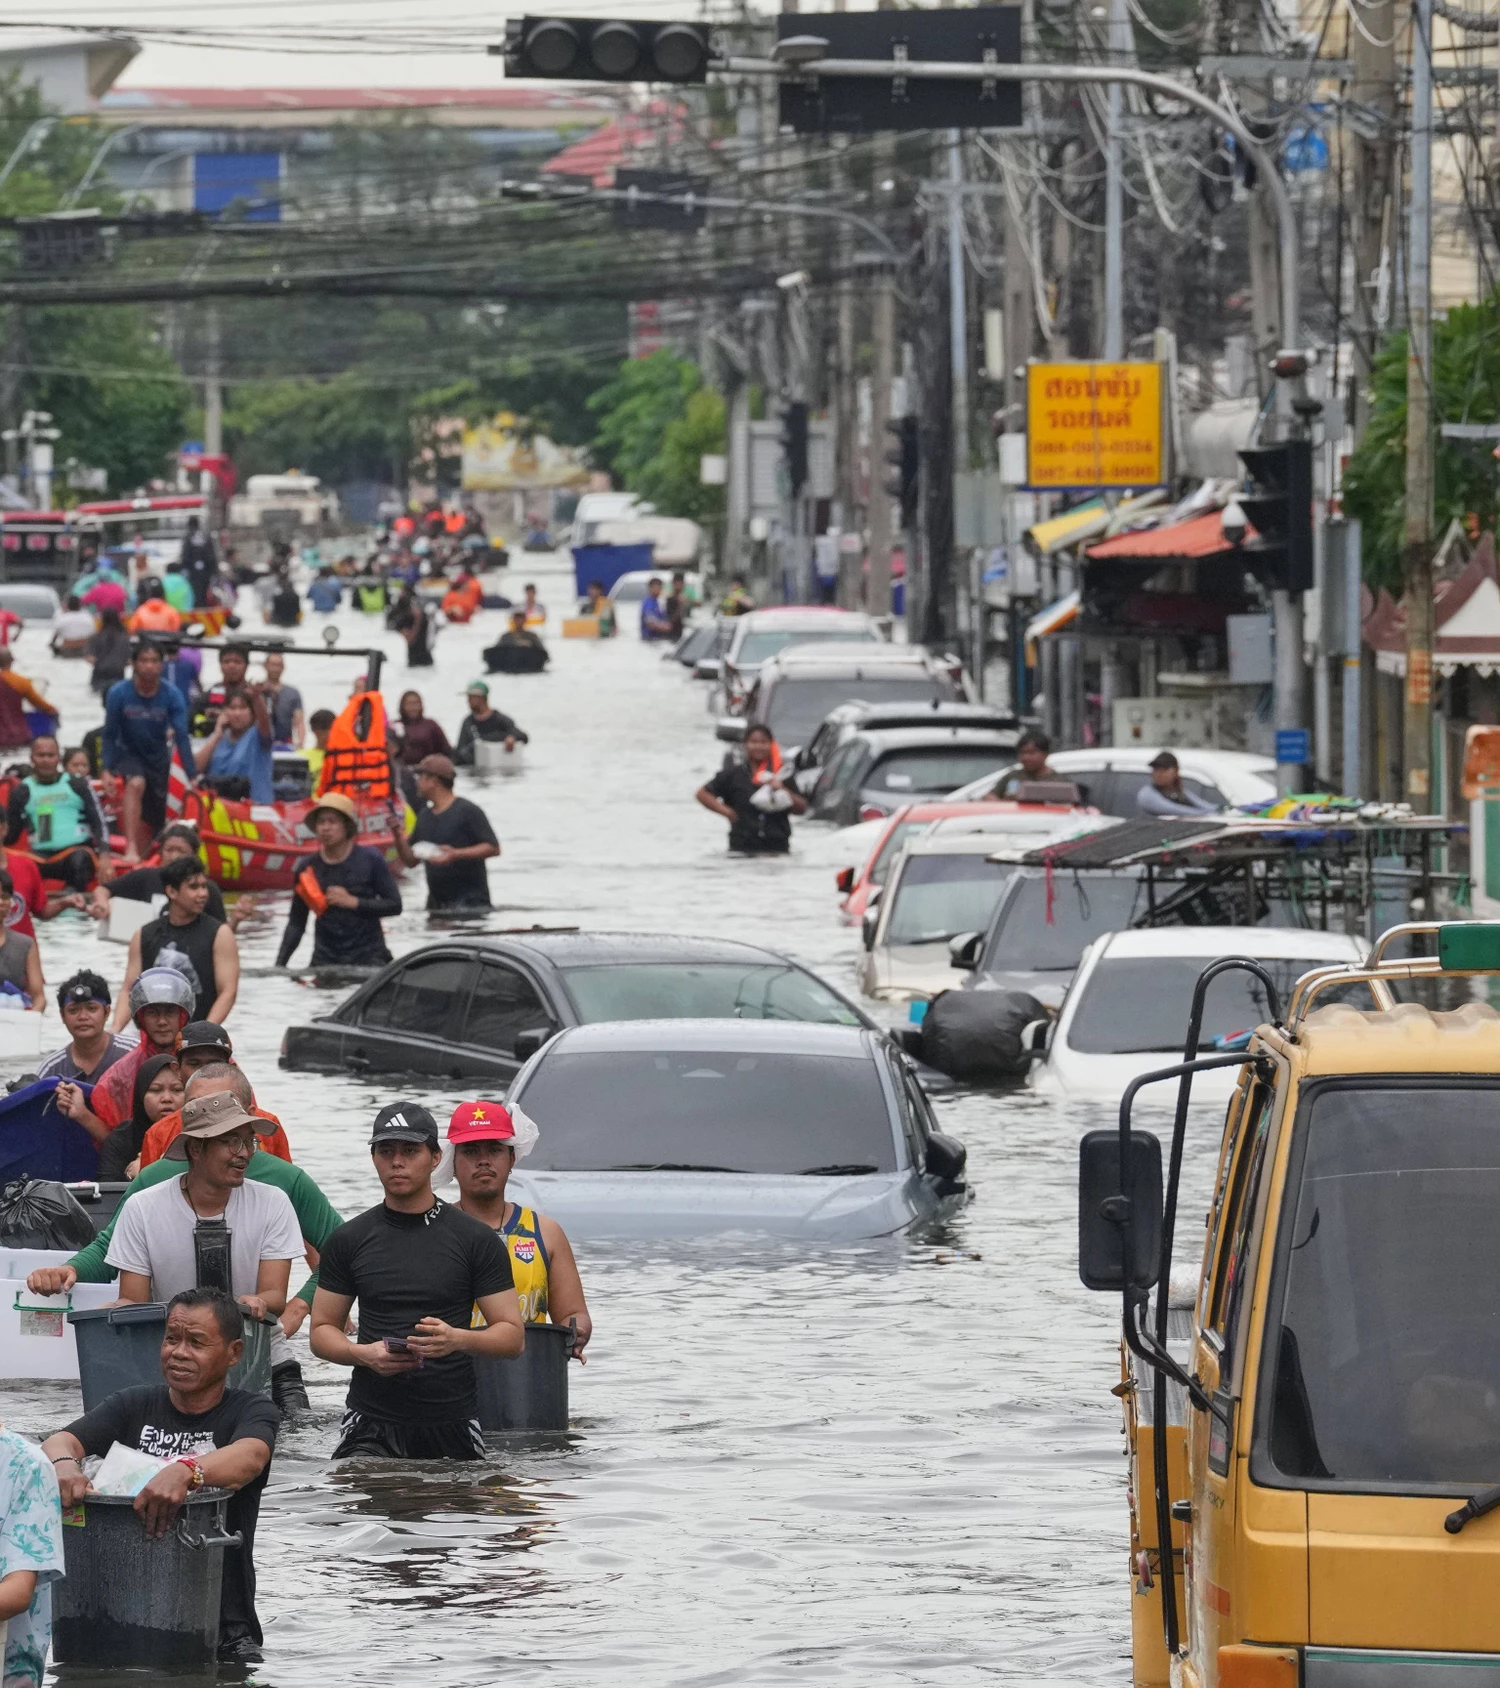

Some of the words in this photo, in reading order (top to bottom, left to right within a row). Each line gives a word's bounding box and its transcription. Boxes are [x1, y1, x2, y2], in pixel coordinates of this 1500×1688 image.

[1046, 401, 1132, 430] รถยนต์
[140, 1425, 182, 1447] Enjoy
[148, 1442, 179, 1457] World
